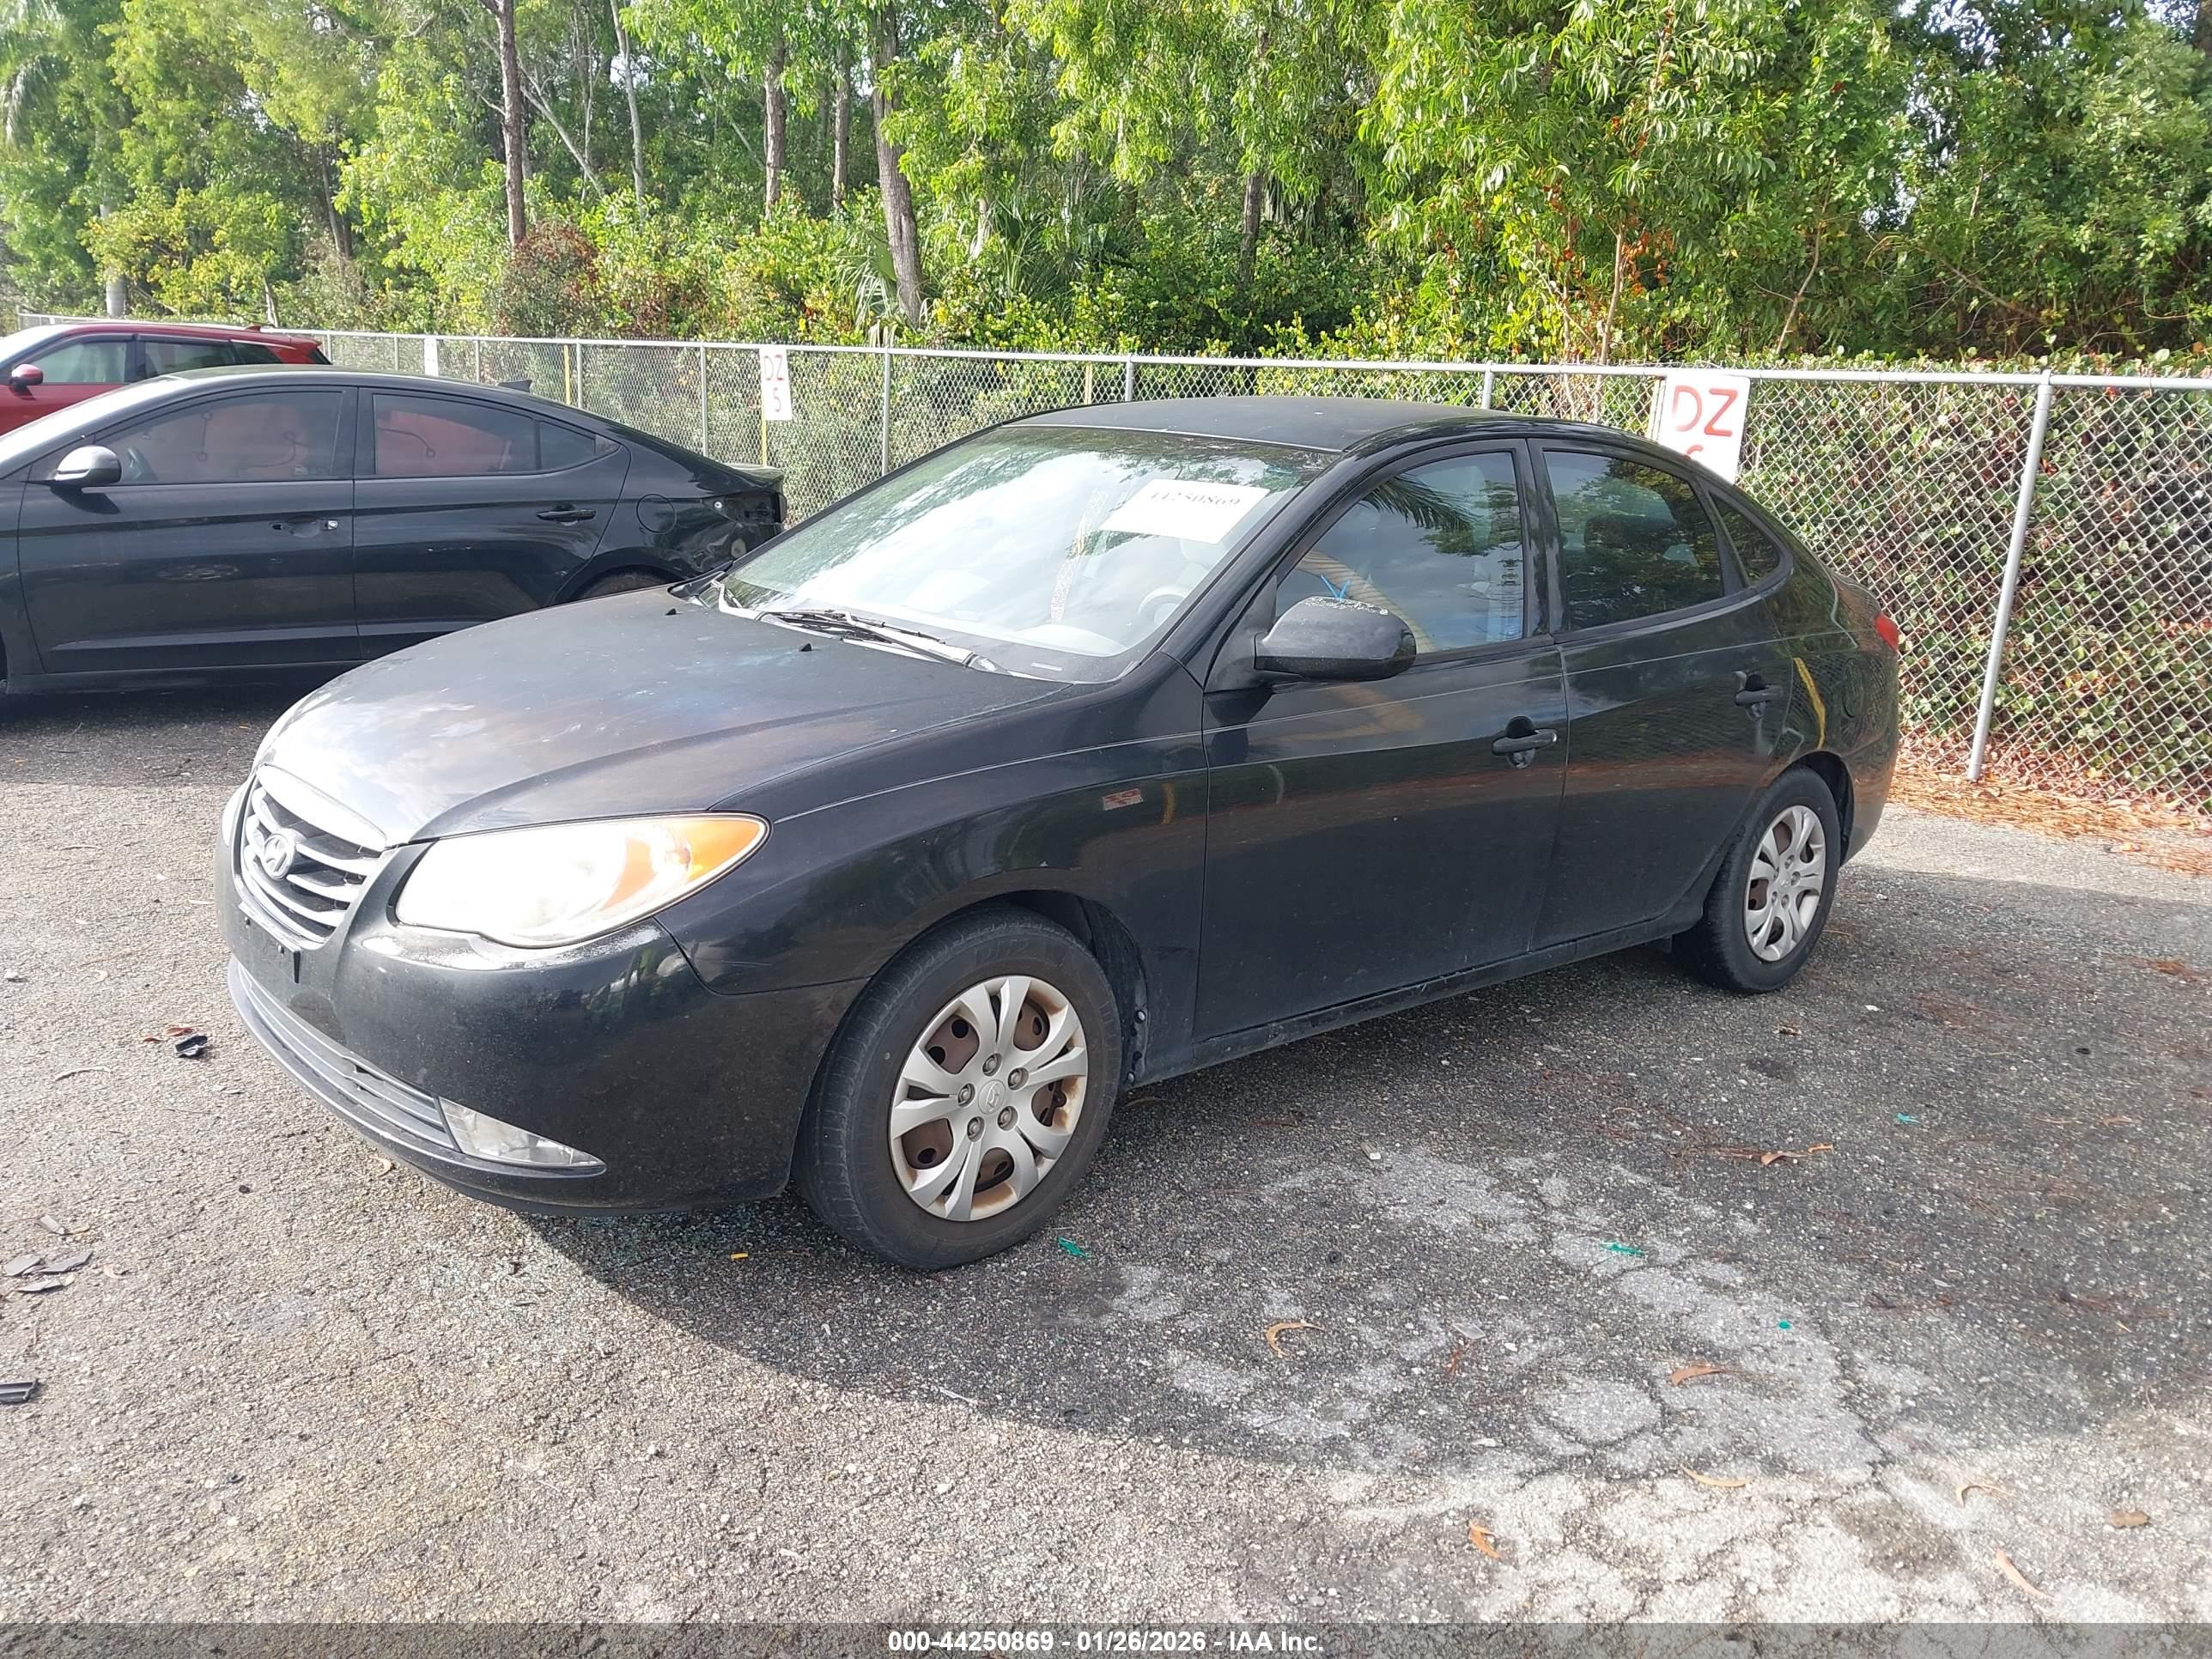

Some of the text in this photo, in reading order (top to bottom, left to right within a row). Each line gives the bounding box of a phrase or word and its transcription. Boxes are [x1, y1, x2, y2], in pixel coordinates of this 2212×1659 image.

[763, 354, 785, 381] DZ
[773, 386, 782, 413] 5
[1672, 385, 1739, 437] DZ
